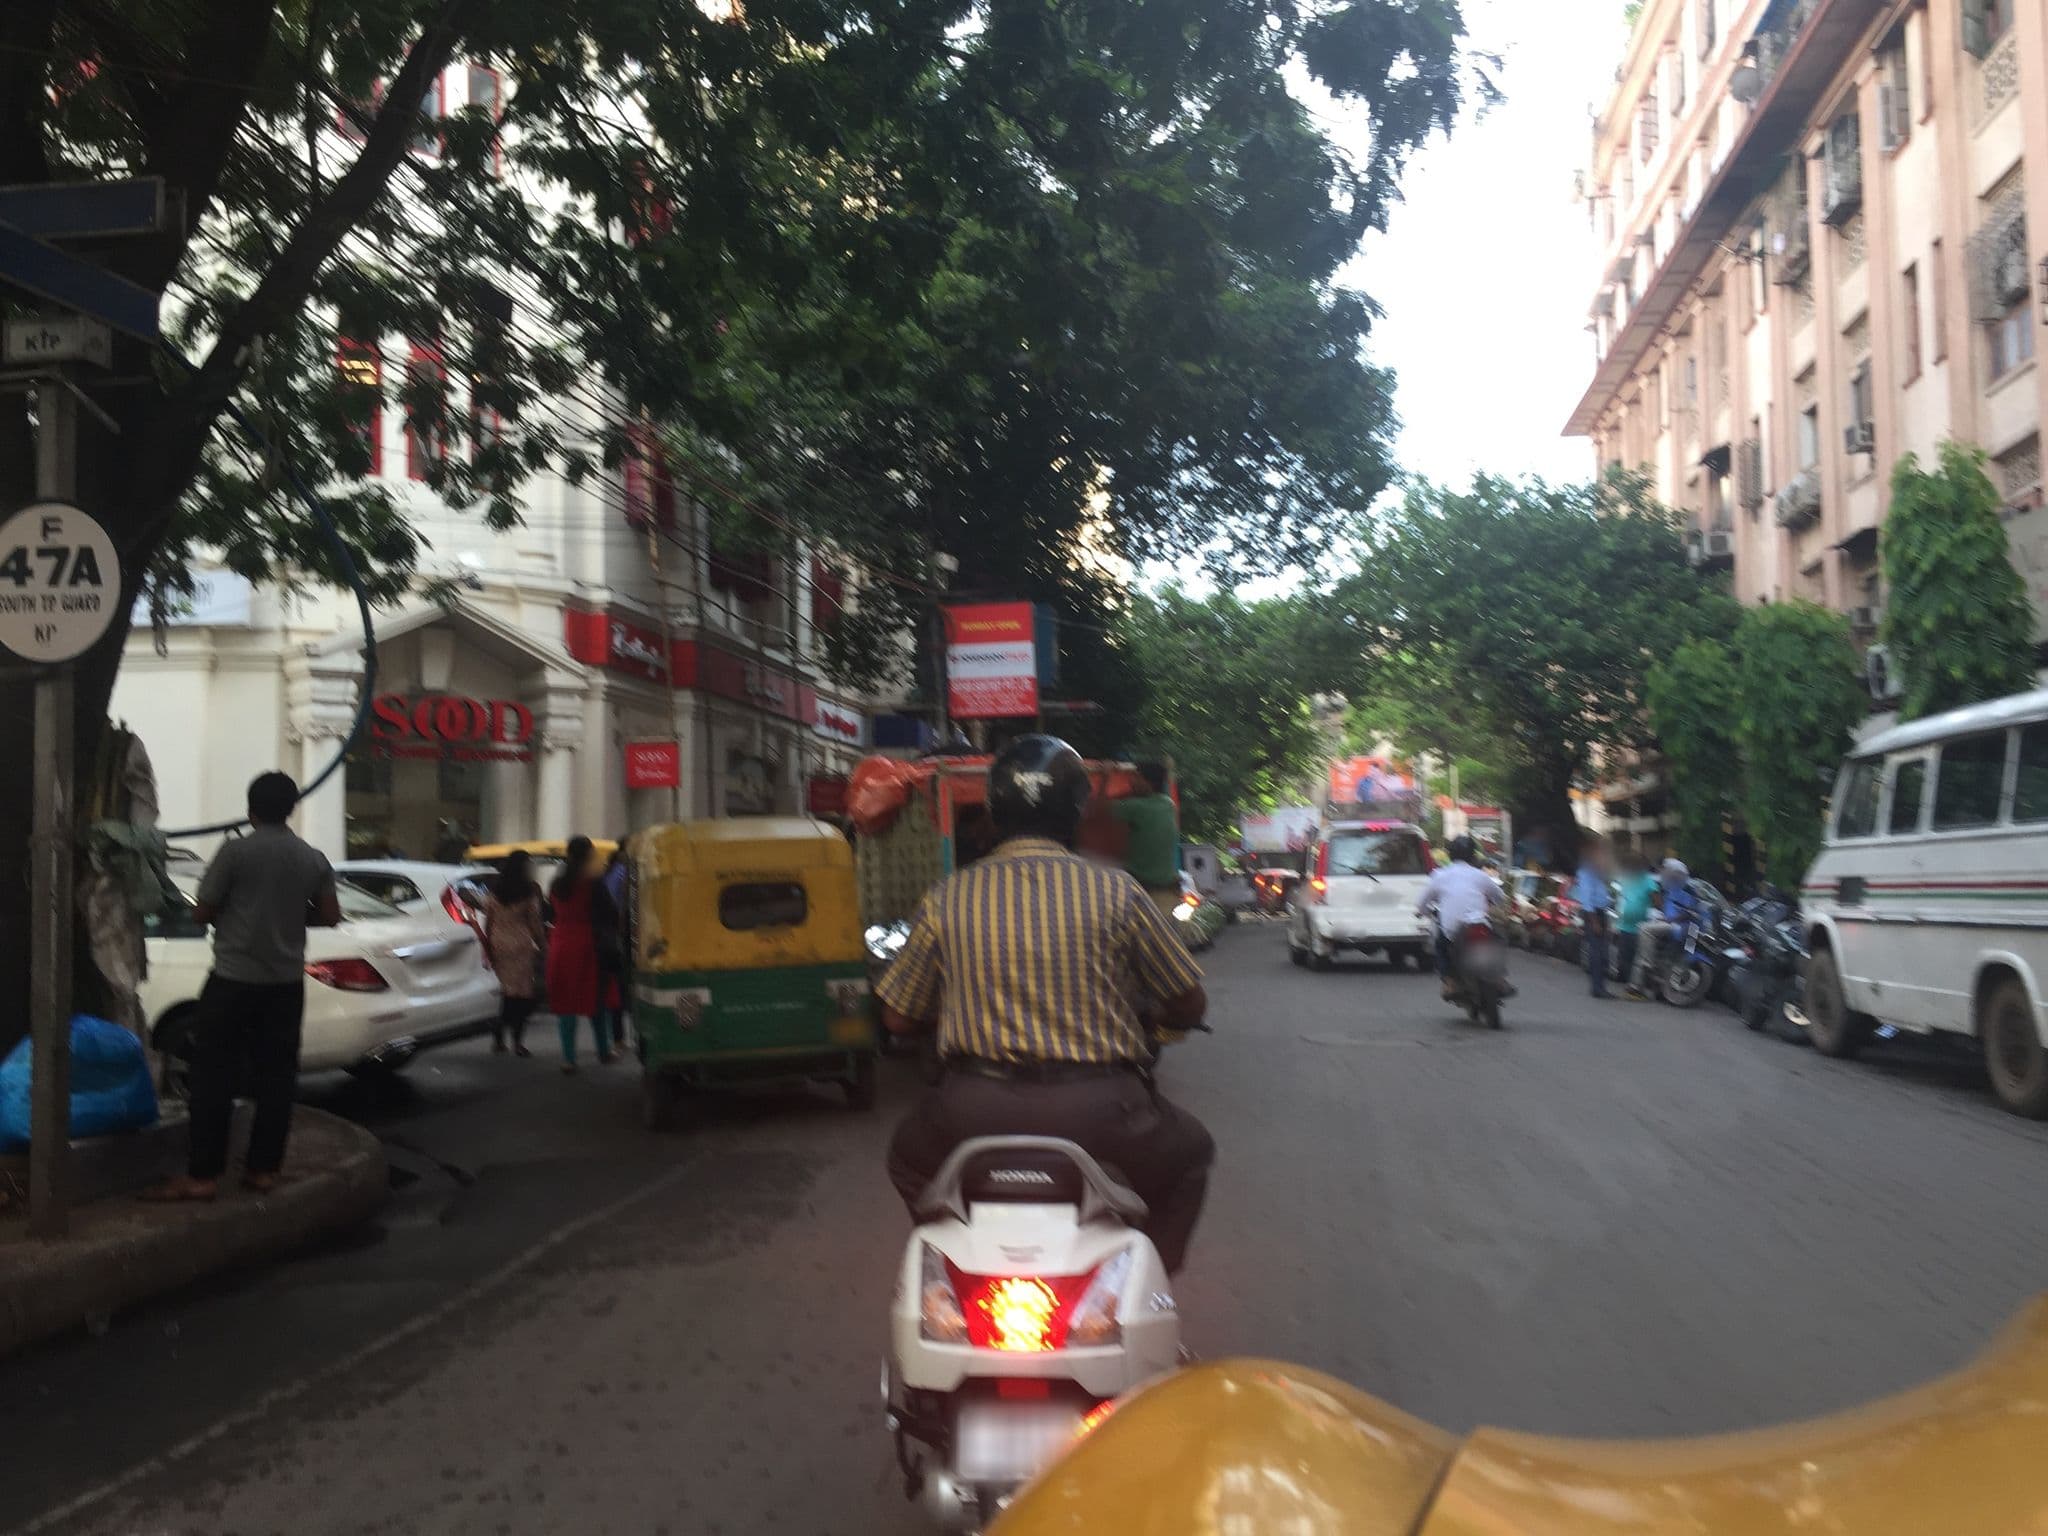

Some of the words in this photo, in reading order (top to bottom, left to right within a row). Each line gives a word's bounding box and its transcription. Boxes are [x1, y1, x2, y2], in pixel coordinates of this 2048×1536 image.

[0, 545, 103, 587] 47A
[371, 693, 534, 744] SOOD
[989, 1169, 1055, 1184] HONDA
